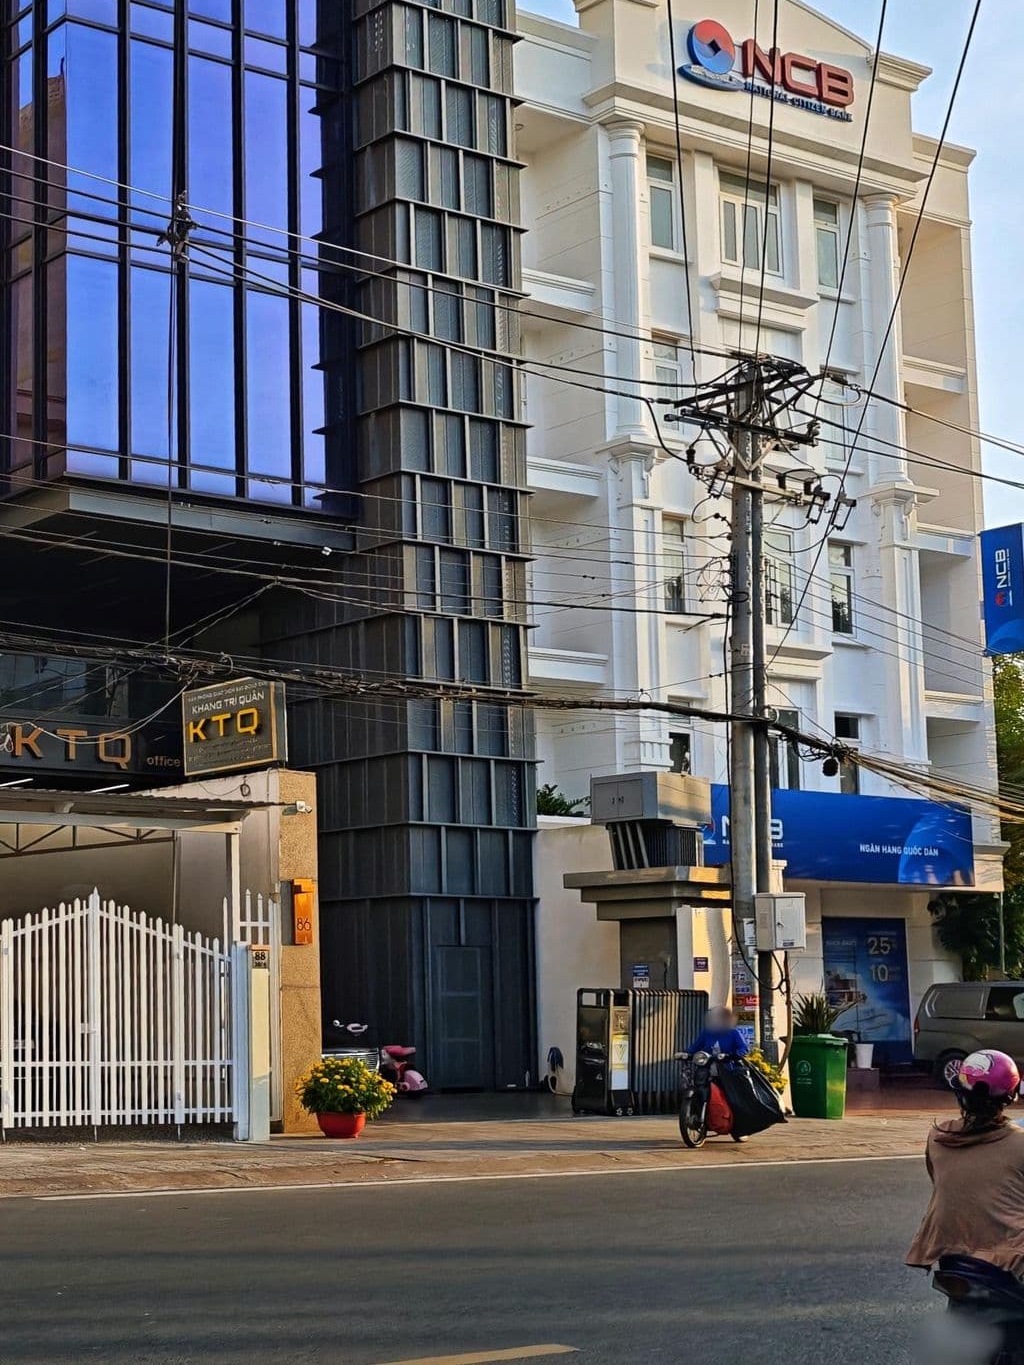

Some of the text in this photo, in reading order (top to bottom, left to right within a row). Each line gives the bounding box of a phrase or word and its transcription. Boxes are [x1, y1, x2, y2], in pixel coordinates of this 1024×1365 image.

[742, 38, 854, 108] NCB
[995, 549, 1007, 589] NCB
[192, 700, 222, 714] KHANG
[188, 707, 259, 743] KTQ
[15, 724, 132, 770] KTQ
[146, 754, 181, 768] office
[297, 917, 312, 931] 86
[254, 951, 266, 961] 88
[867, 937, 891, 955] 25
